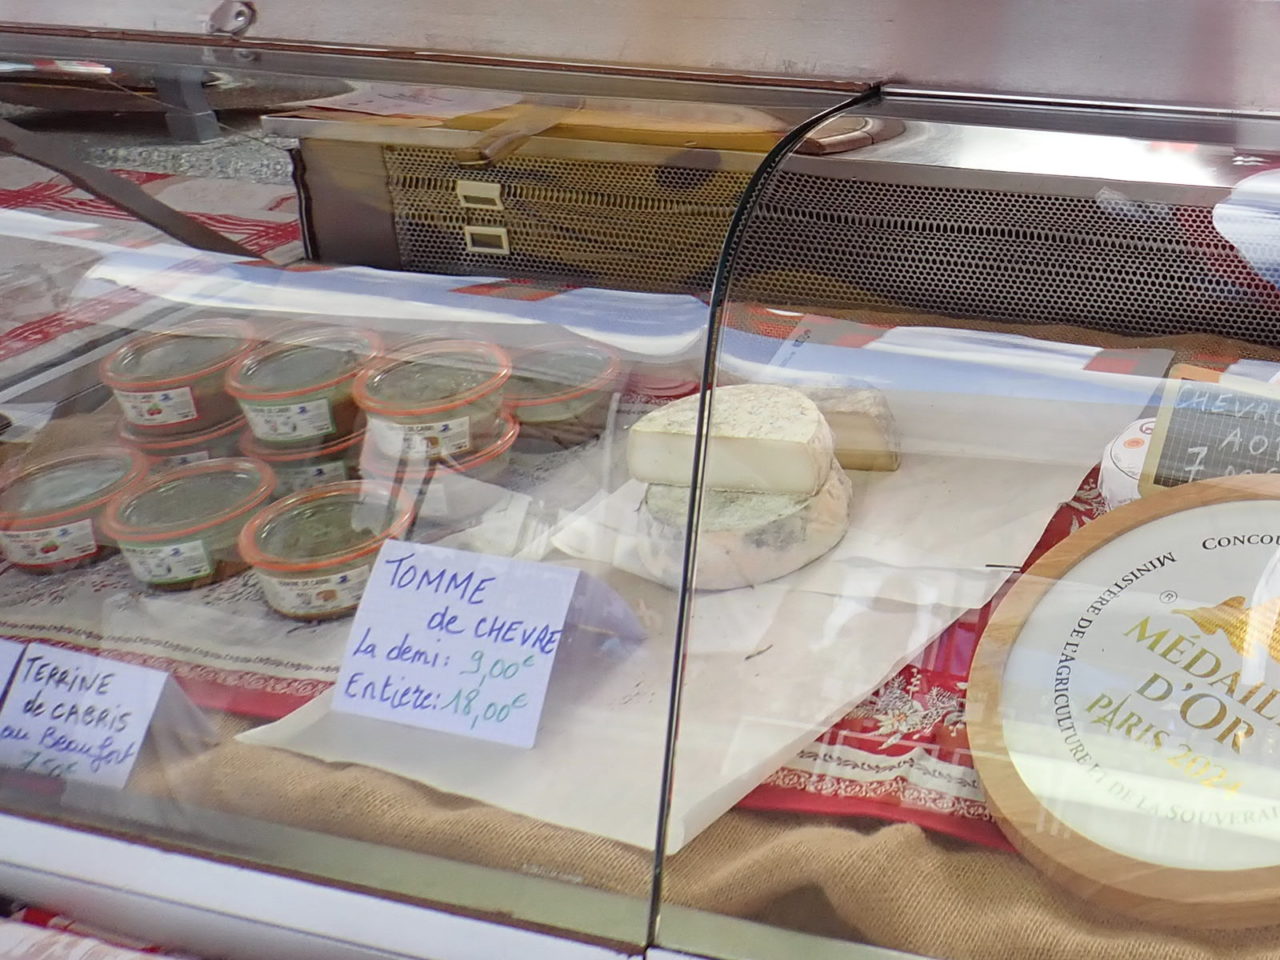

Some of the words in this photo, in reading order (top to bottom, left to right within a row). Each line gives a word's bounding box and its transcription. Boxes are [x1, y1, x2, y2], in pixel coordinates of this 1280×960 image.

[385, 553, 495, 605] TOMME
[427, 606, 465, 634] de
[1070, 616, 1094, 640] DE
[1054, 641, 1092, 766] L'AGRICULTURE
[1084, 693, 1170, 752] PARIS
[1136, 672, 1254, 755] D'OR
